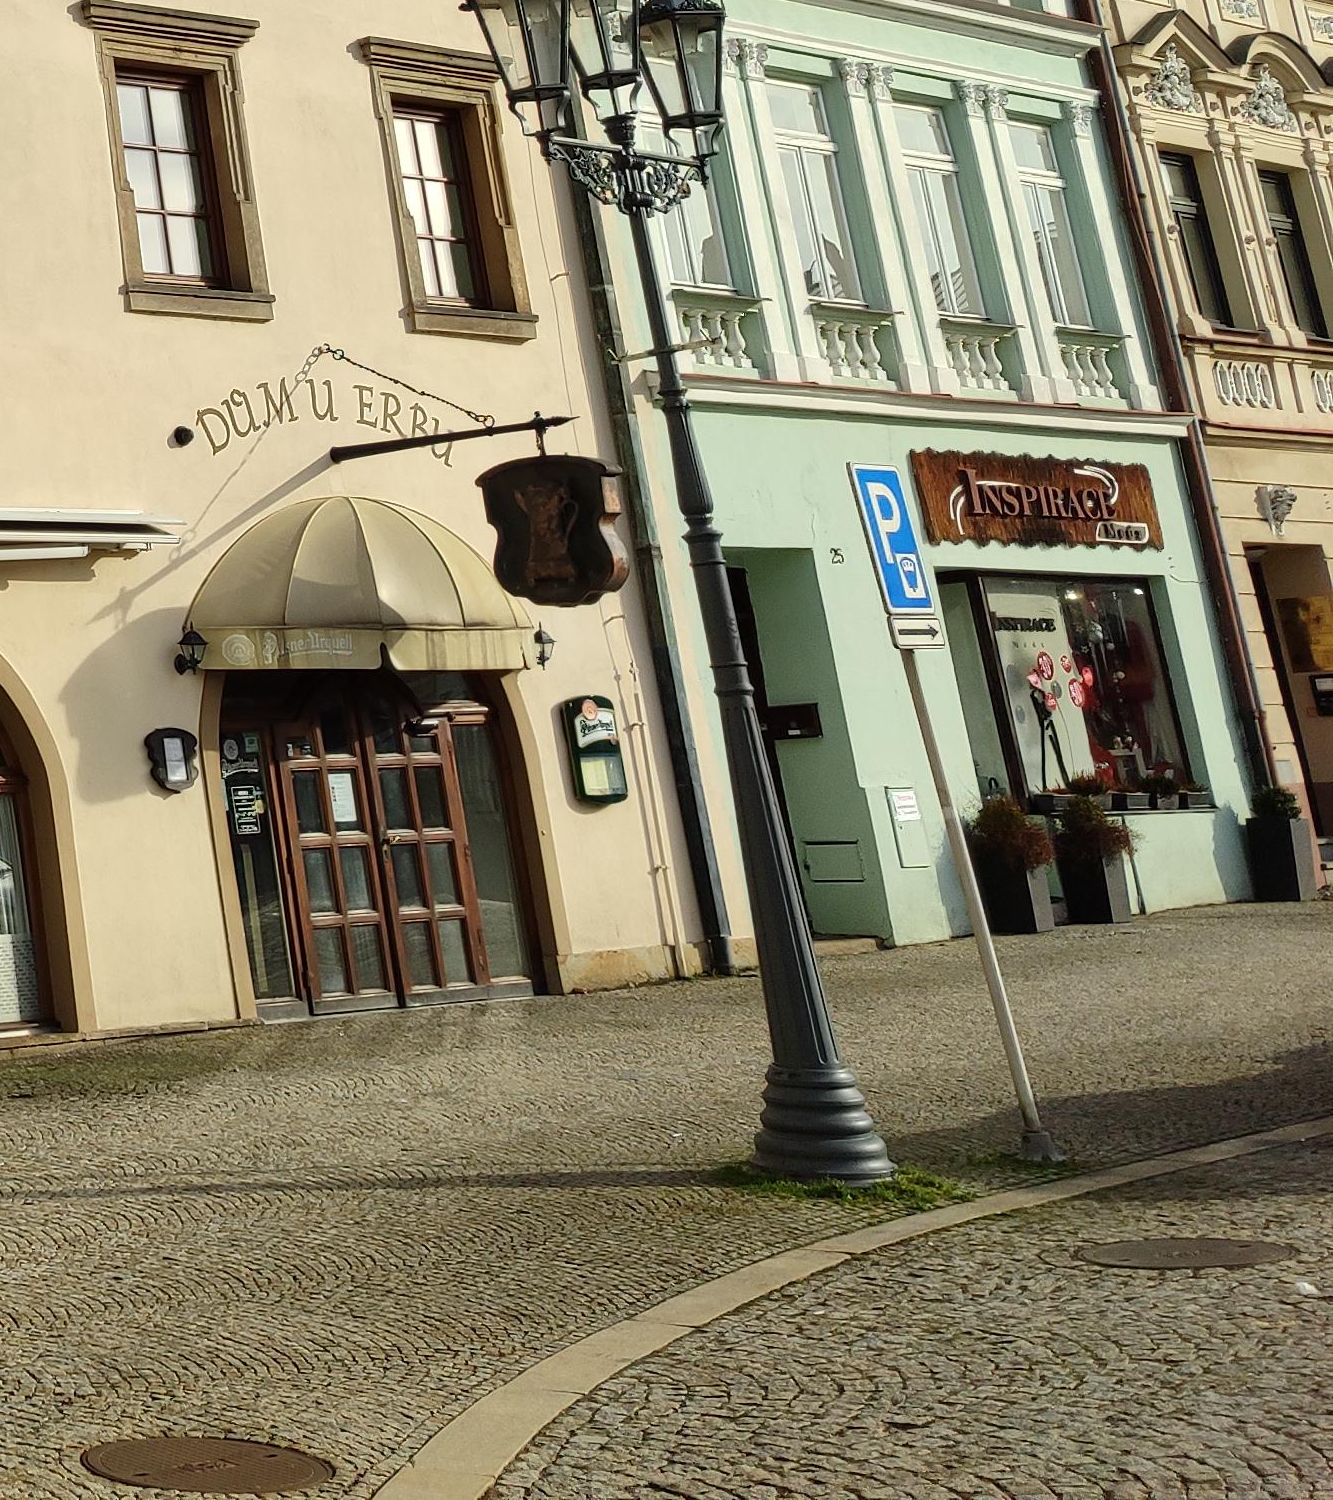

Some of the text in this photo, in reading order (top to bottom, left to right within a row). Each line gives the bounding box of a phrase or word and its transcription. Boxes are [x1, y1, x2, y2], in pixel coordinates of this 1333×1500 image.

[305, 378, 339, 421] U
[958, 466, 1118, 521] INSPIRACE
[865, 482, 901, 564] P
